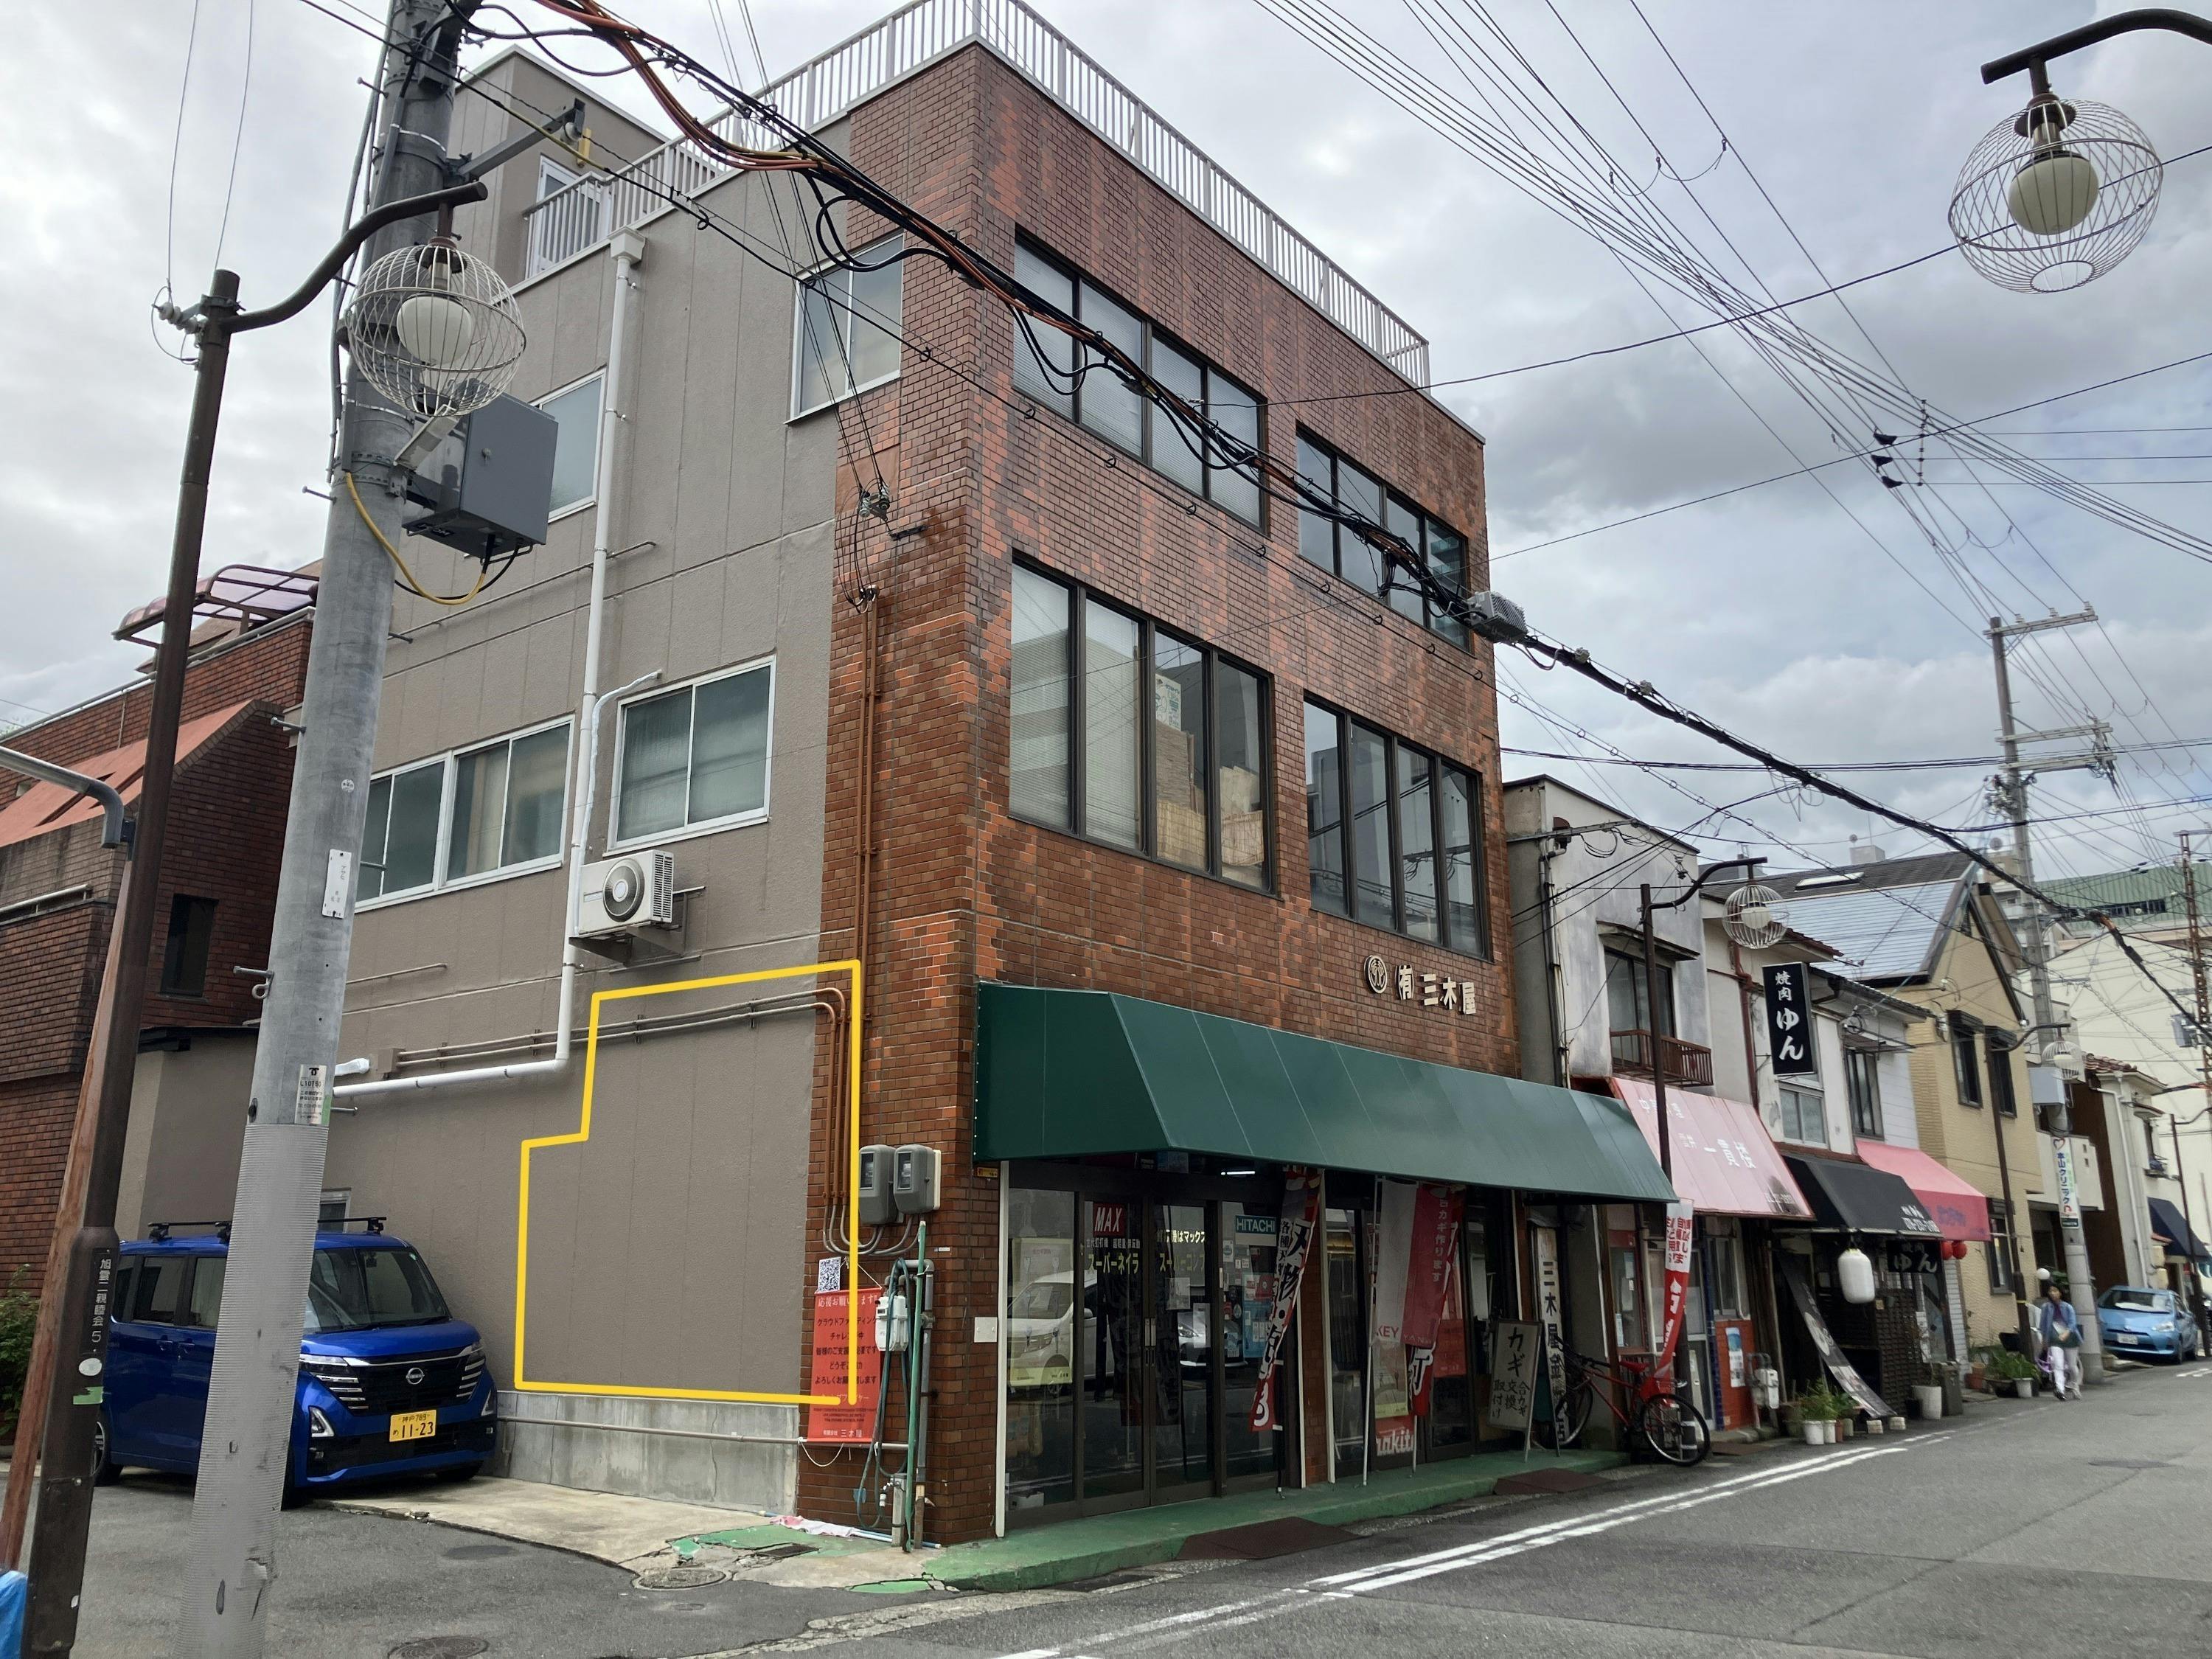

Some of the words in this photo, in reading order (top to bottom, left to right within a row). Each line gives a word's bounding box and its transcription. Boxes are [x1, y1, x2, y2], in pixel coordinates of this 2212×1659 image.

[1775, 970, 1792, 1001] 焼肉
[1776, 1007, 1804, 1060] ゆん
[1094, 1207, 1123, 1232] MAX
[1237, 1217, 1276, 1233] HITACHI
[1508, 1327, 1525, 1377] カギ
[402, 1422, 434, 1439] 11-23
